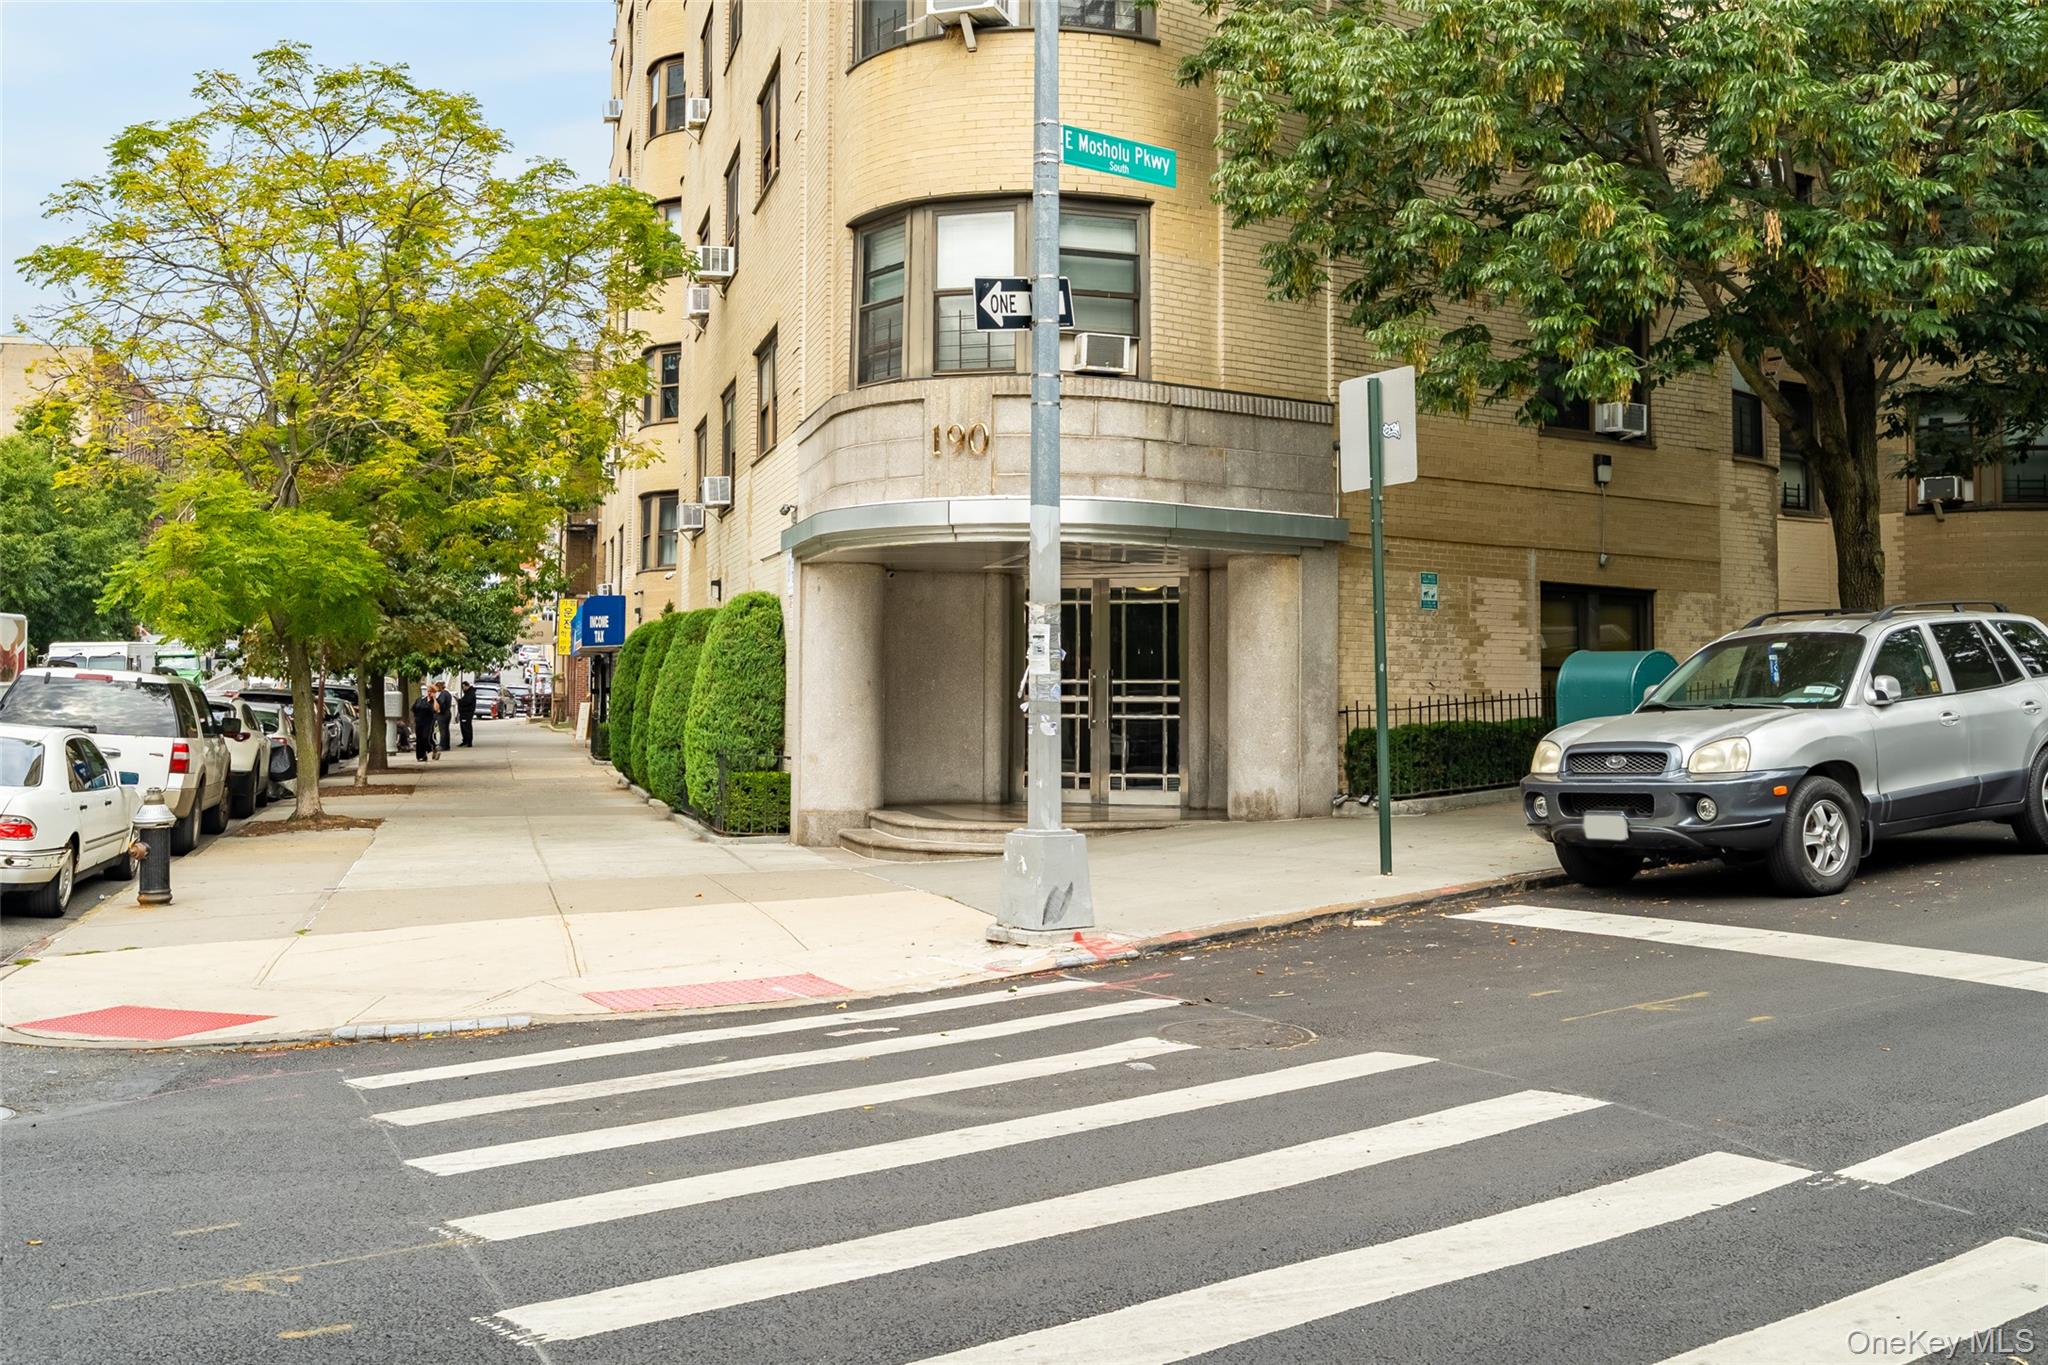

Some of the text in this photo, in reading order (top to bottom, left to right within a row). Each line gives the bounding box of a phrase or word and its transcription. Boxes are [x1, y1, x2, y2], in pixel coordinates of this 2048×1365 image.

[1065, 130, 1170, 176] E Mosholu Pkwy
[1109, 161, 1129, 174] South
[990, 294, 1017, 314] ONE
[932, 423, 989, 456] 190
[589, 615, 609, 629] INCOME
[594, 630, 605, 643] TAX
